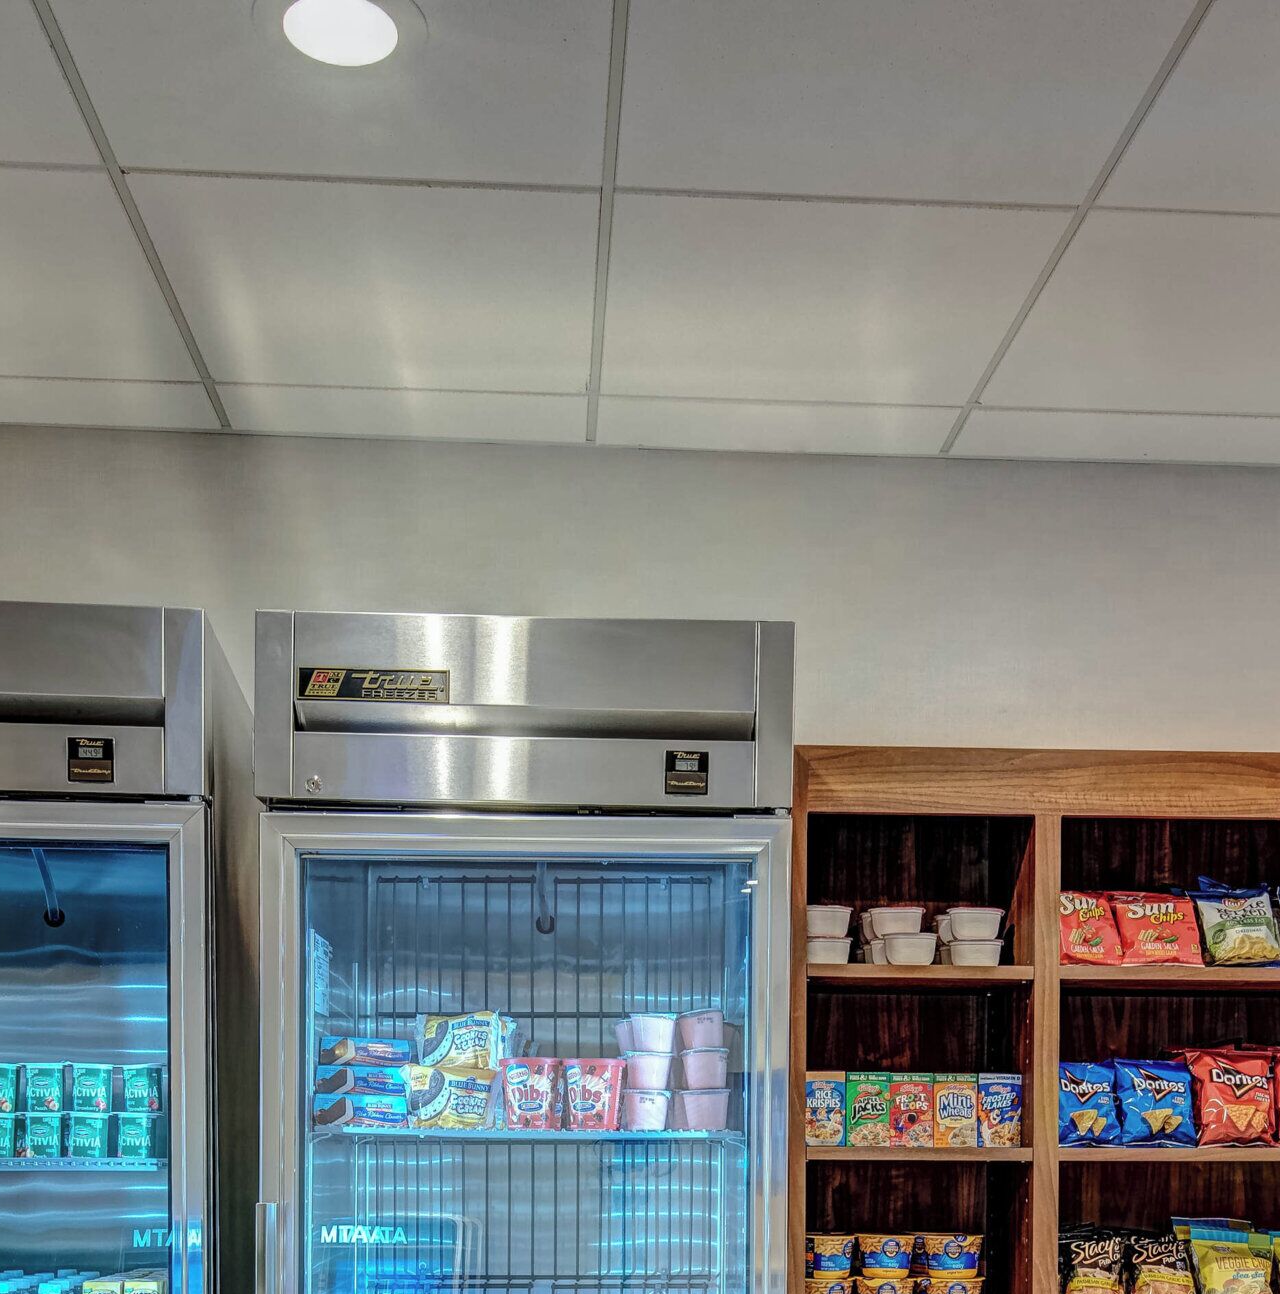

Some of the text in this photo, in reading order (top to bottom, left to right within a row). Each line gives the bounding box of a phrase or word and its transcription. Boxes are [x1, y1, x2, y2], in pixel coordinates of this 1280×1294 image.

[1060, 894, 1097, 915] Sun
[1127, 902, 1174, 919] Sun
[1079, 906, 1105, 922] Chips
[1150, 911, 1184, 924] Chips
[1134, 1077, 1186, 1093] Doritos
[1211, 1068, 1269, 1089] Doritos
[26, 1086, 60, 1097] ACTIVIA
[73, 1086, 107, 1098] ACTIVIA
[124, 1086, 159, 1098] ACTIVIA
[511, 1084, 548, 1103] Dibs
[1061, 1079, 1110, 1094] Doritos
[815, 1090, 832, 1099] RICE
[940, 1092, 972, 1108] Mini
[982, 1092, 1017, 1105] FROSTED
[806, 1098, 841, 1108] KRISPIES
[983, 1100, 1012, 1111] FLAKES
[851, 1102, 886, 1124] JACKS
[939, 1105, 972, 1120] Wheats
[1070, 1236, 1121, 1265] Stacy's
[1132, 1240, 1185, 1264] Stacy's
[1215, 1257, 1250, 1270] VEGGIE
[1232, 1271, 1250, 1279] Sea
